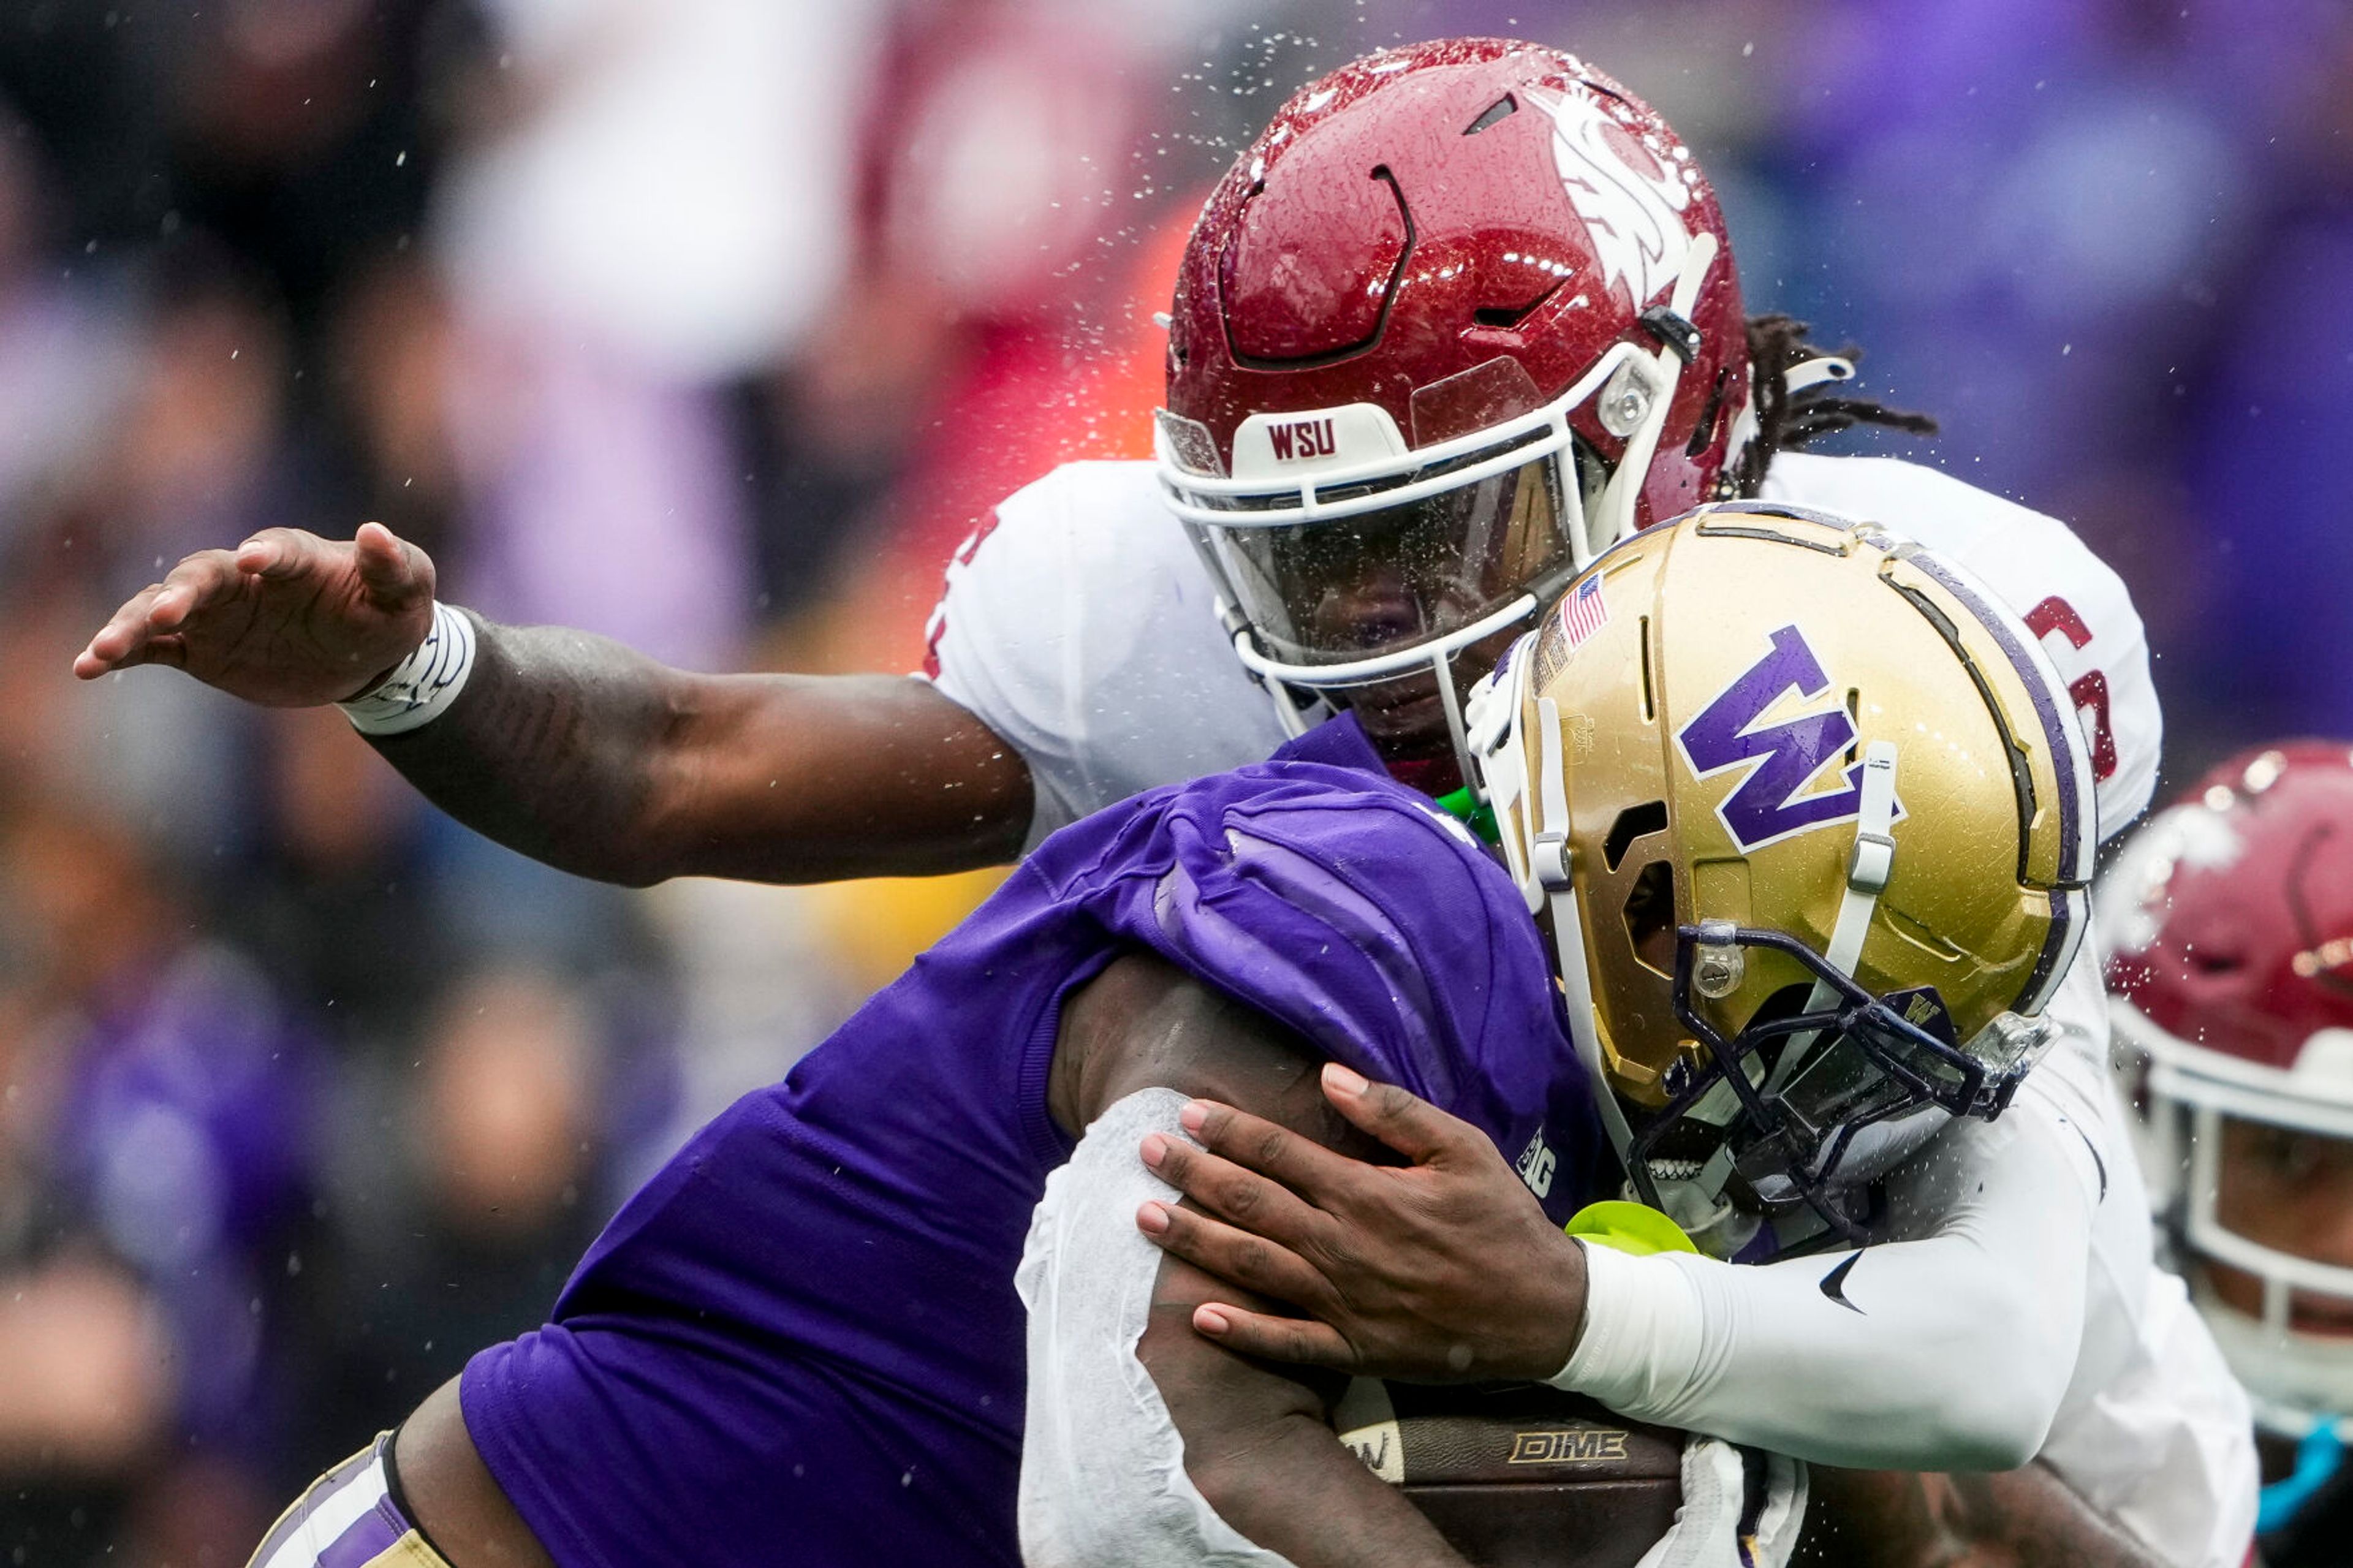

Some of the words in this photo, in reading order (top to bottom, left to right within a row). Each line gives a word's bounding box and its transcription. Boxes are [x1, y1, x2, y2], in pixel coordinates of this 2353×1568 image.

[1267, 418, 1335, 460] WSU
[1672, 620, 1909, 855] W
[1904, 993, 1941, 1027] W
[1508, 1430, 1629, 1464] DIME
